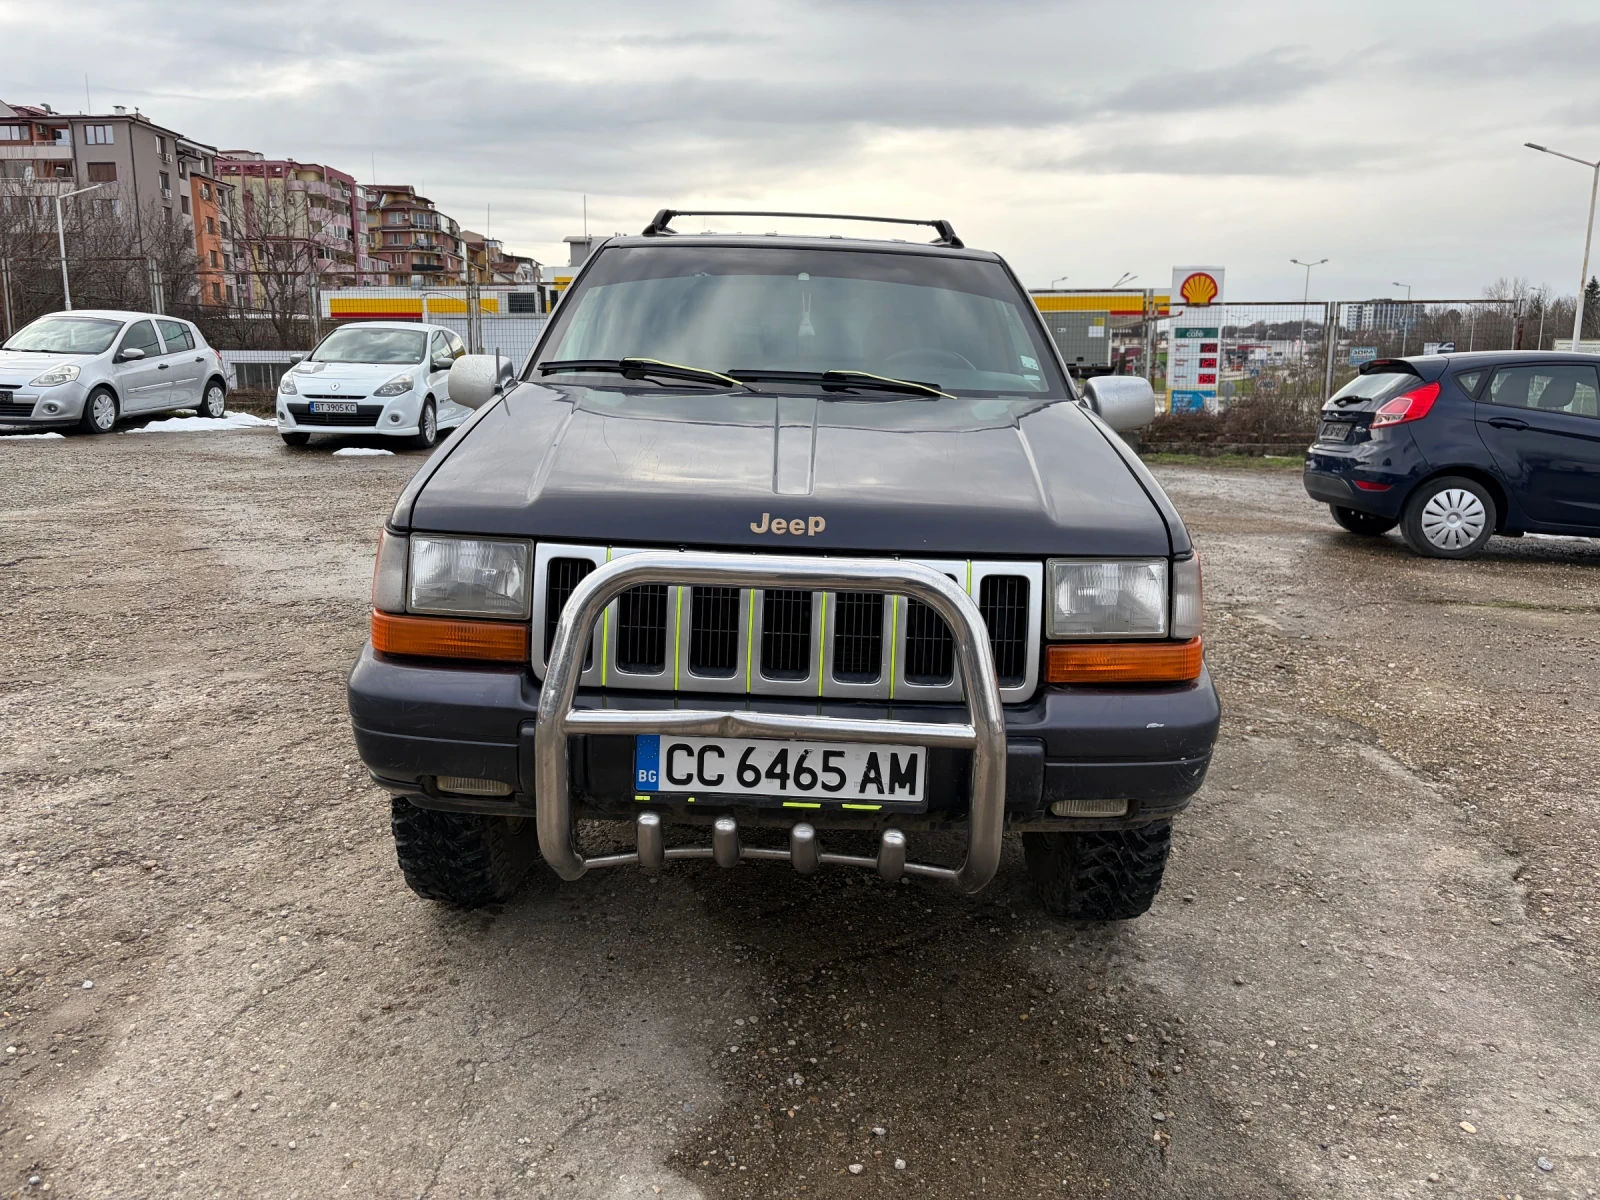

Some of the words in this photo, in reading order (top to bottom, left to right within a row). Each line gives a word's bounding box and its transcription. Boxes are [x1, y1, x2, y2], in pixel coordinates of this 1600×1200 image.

[326, 404, 345, 412] 3905
[750, 512, 826, 537] Jeep
[638, 769, 657, 783] BG
[666, 743, 726, 787] CC
[736, 746, 847, 793] 6465
[858, 751, 919, 796] AM
